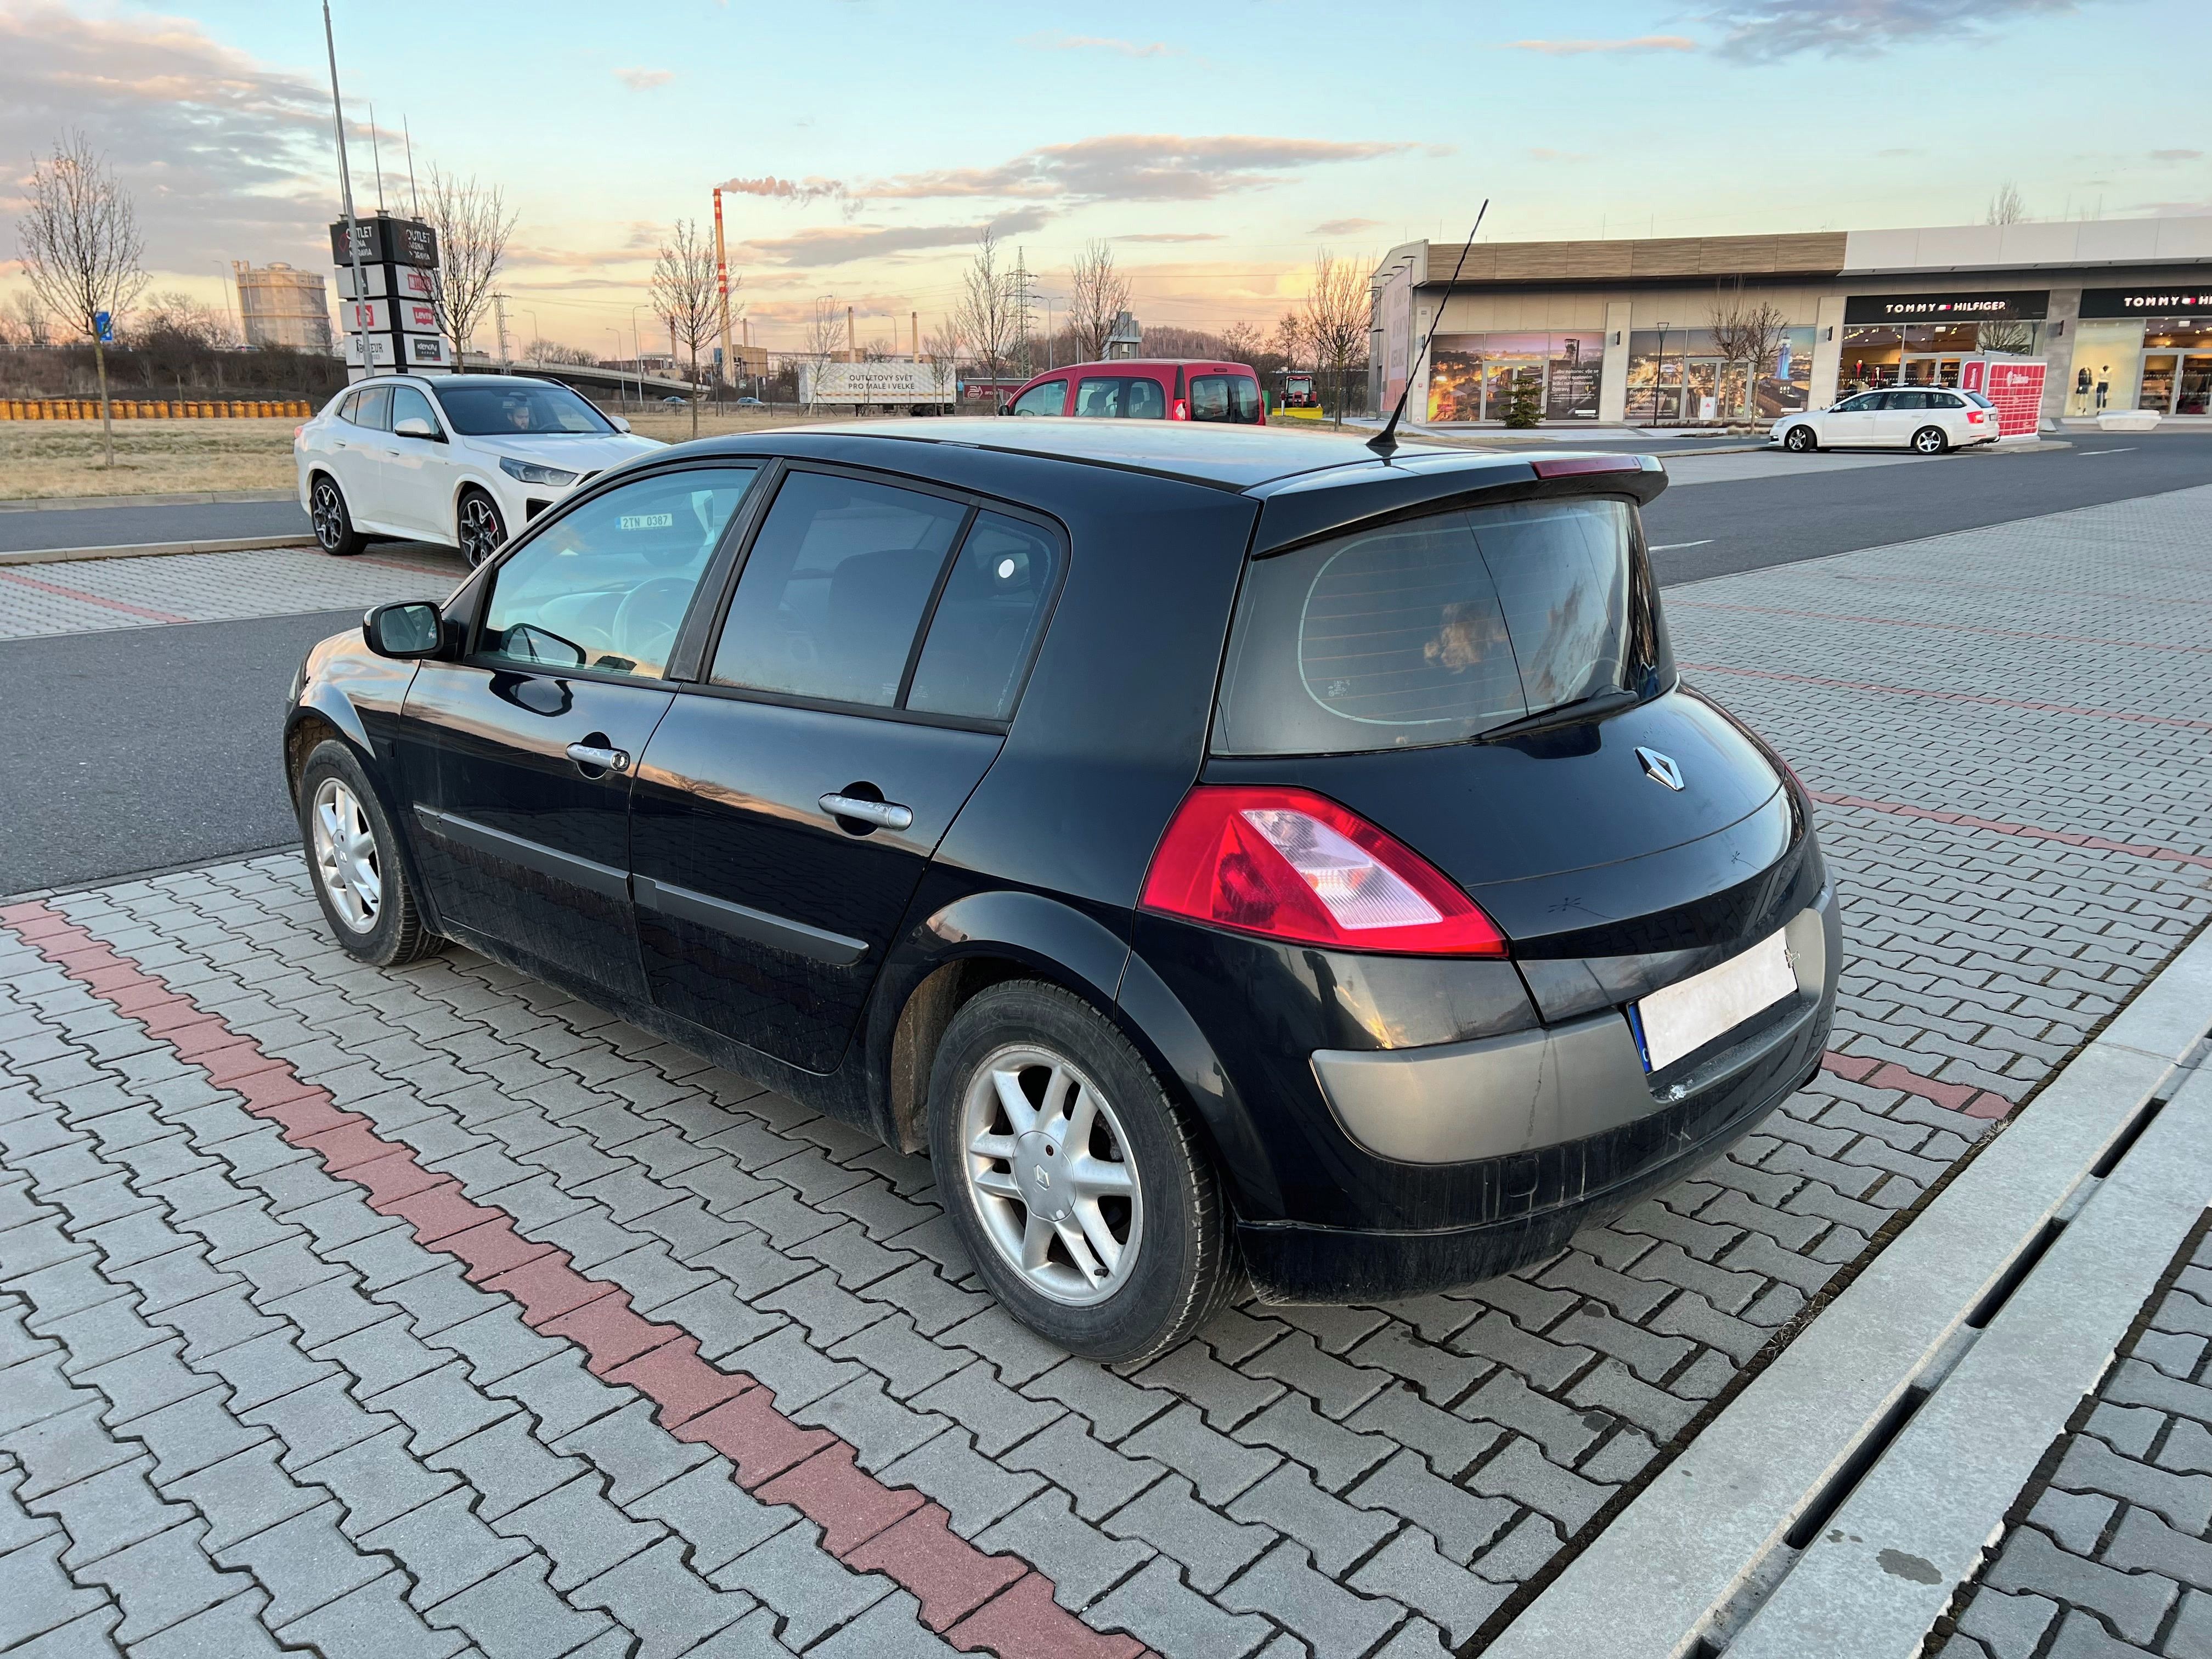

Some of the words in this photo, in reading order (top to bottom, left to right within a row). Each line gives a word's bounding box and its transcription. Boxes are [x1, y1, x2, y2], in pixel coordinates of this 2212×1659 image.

[346, 226, 373, 240] OTLET
[1886, 303, 1936, 313] TOMMY
[1953, 301, 2006, 312] HILFIGER
[2124, 296, 2180, 307] TOMMY
[623, 517, 640, 528] 2TN
[647, 515, 668, 526] 0387
